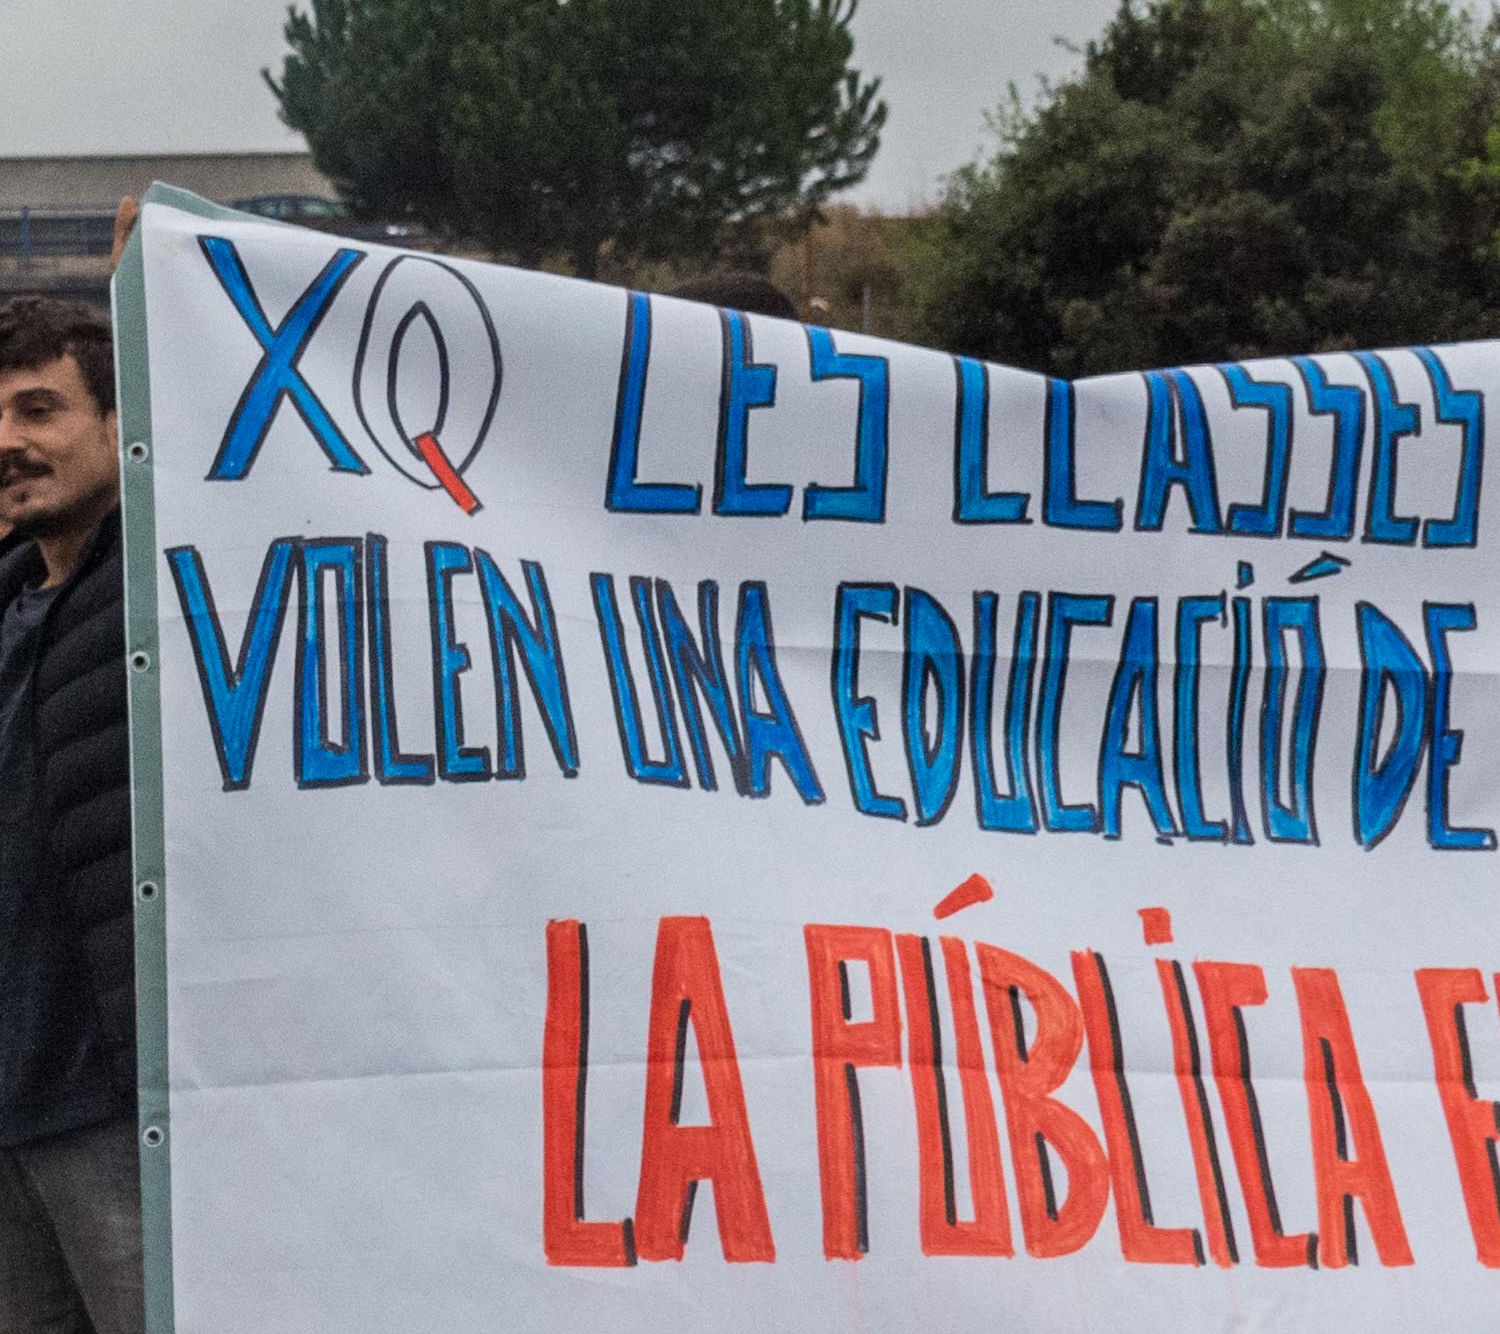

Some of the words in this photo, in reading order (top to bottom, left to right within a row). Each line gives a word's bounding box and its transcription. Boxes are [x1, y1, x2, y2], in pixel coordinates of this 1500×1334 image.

[198, 233, 503, 516] XQ
[604, 289, 890, 525] LES
[163, 530, 580, 792] VOLEN
[589, 569, 827, 805] UNA
[1352, 599, 1499, 850] DE
[542, 913, 776, 1269] LA
[803, 874, 1416, 1272] PÚBLICA
